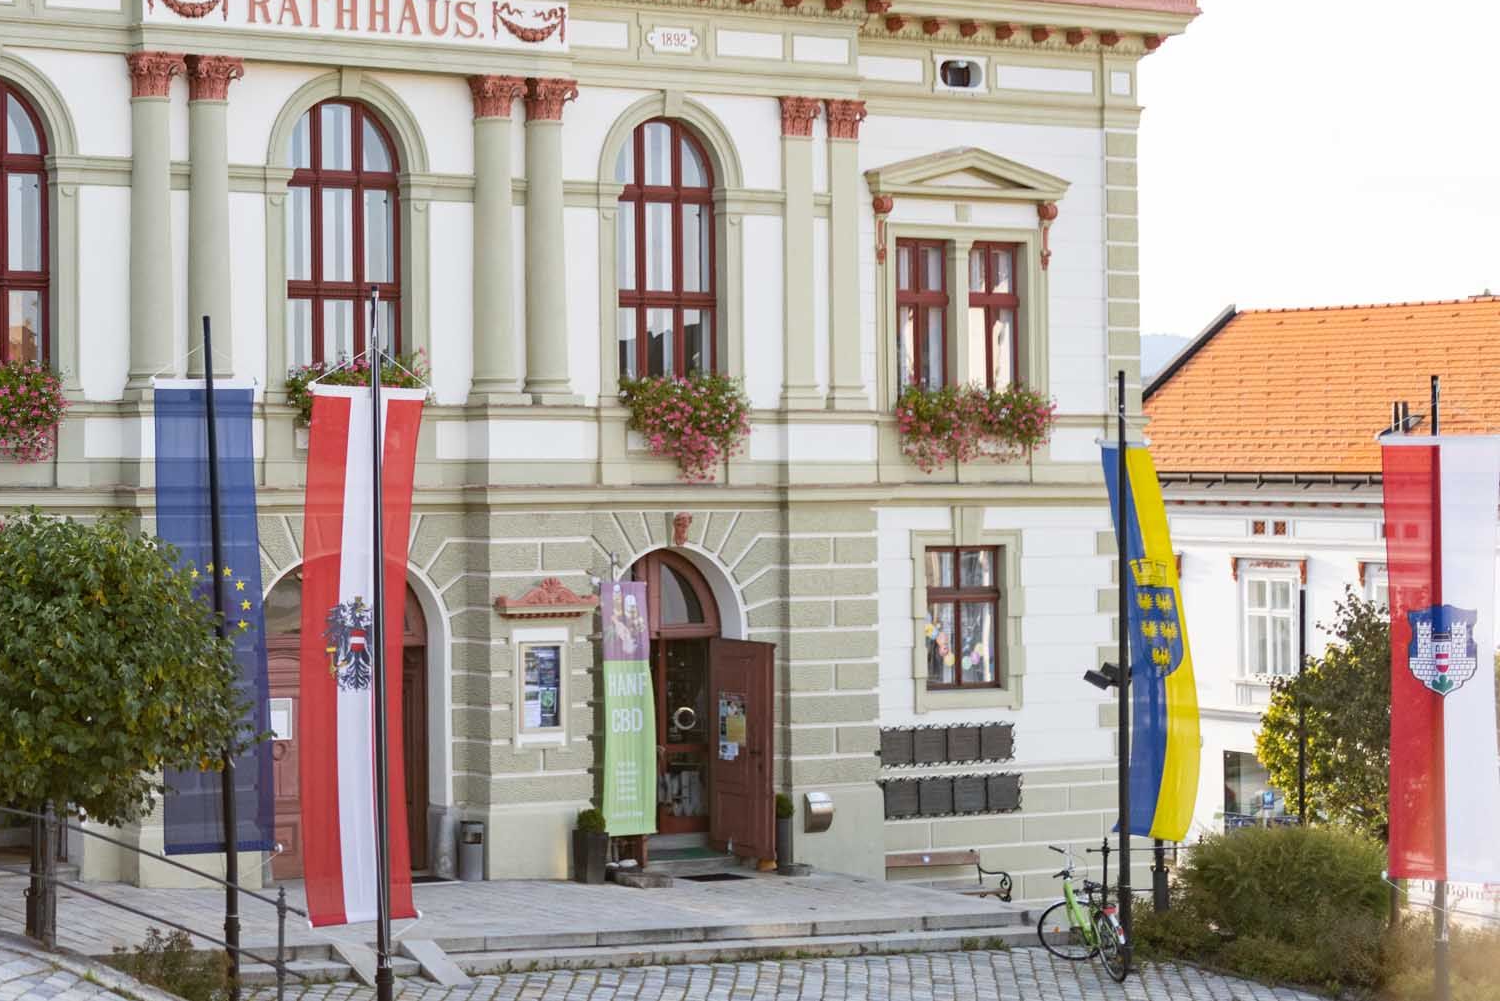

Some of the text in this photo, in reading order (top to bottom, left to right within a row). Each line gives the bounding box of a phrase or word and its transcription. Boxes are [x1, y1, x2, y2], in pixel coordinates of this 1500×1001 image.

[661, 31, 687, 48] 1892
[608, 672, 647, 697] HANF
[611, 708, 644, 733] CBD
